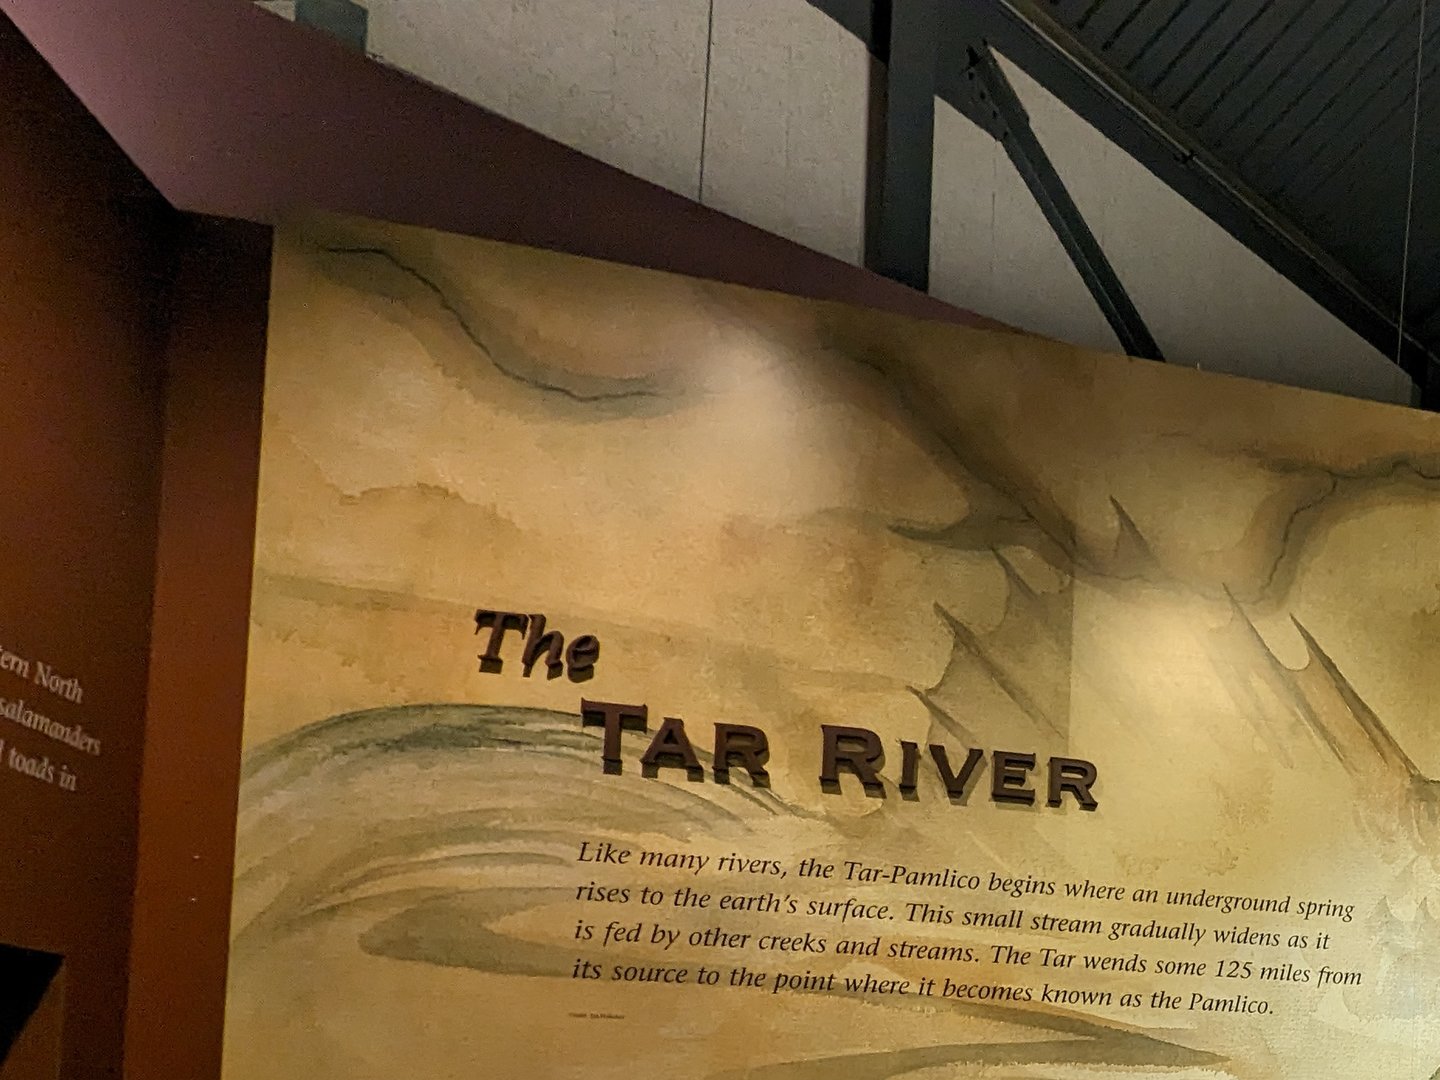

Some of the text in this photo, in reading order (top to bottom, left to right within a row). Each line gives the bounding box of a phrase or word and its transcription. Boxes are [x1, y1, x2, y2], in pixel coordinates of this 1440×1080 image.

[474, 609, 600, 683] The
[35, 661, 82, 703] North
[9, 748, 53, 783] toads
[60, 765, 76, 791] in
[819, 723, 1099, 812] RIVER
[575, 882, 630, 904] rises
[640, 885, 663, 905] to
[673, 888, 711, 908] the
[806, 897, 894, 923] surface.
[905, 903, 953, 925] This
[962, 909, 1022, 929] small
[1030, 914, 1102, 934] stream
[1110, 920, 1206, 946] gradually
[1214, 927, 1280, 947] widens
[1288, 932, 1308, 948] as
[1316, 931, 1330, 949] it
[577, 842, 1354, 922] Like many rivers, the Tar-Pamlico begins where an underground spring
[572, 959, 1274, 1015] its source to the point where it becomes known as the Pamlico.
[574, 920, 1362, 988] is fed by other creeks and streams. The Tar wends some 125 miles from
